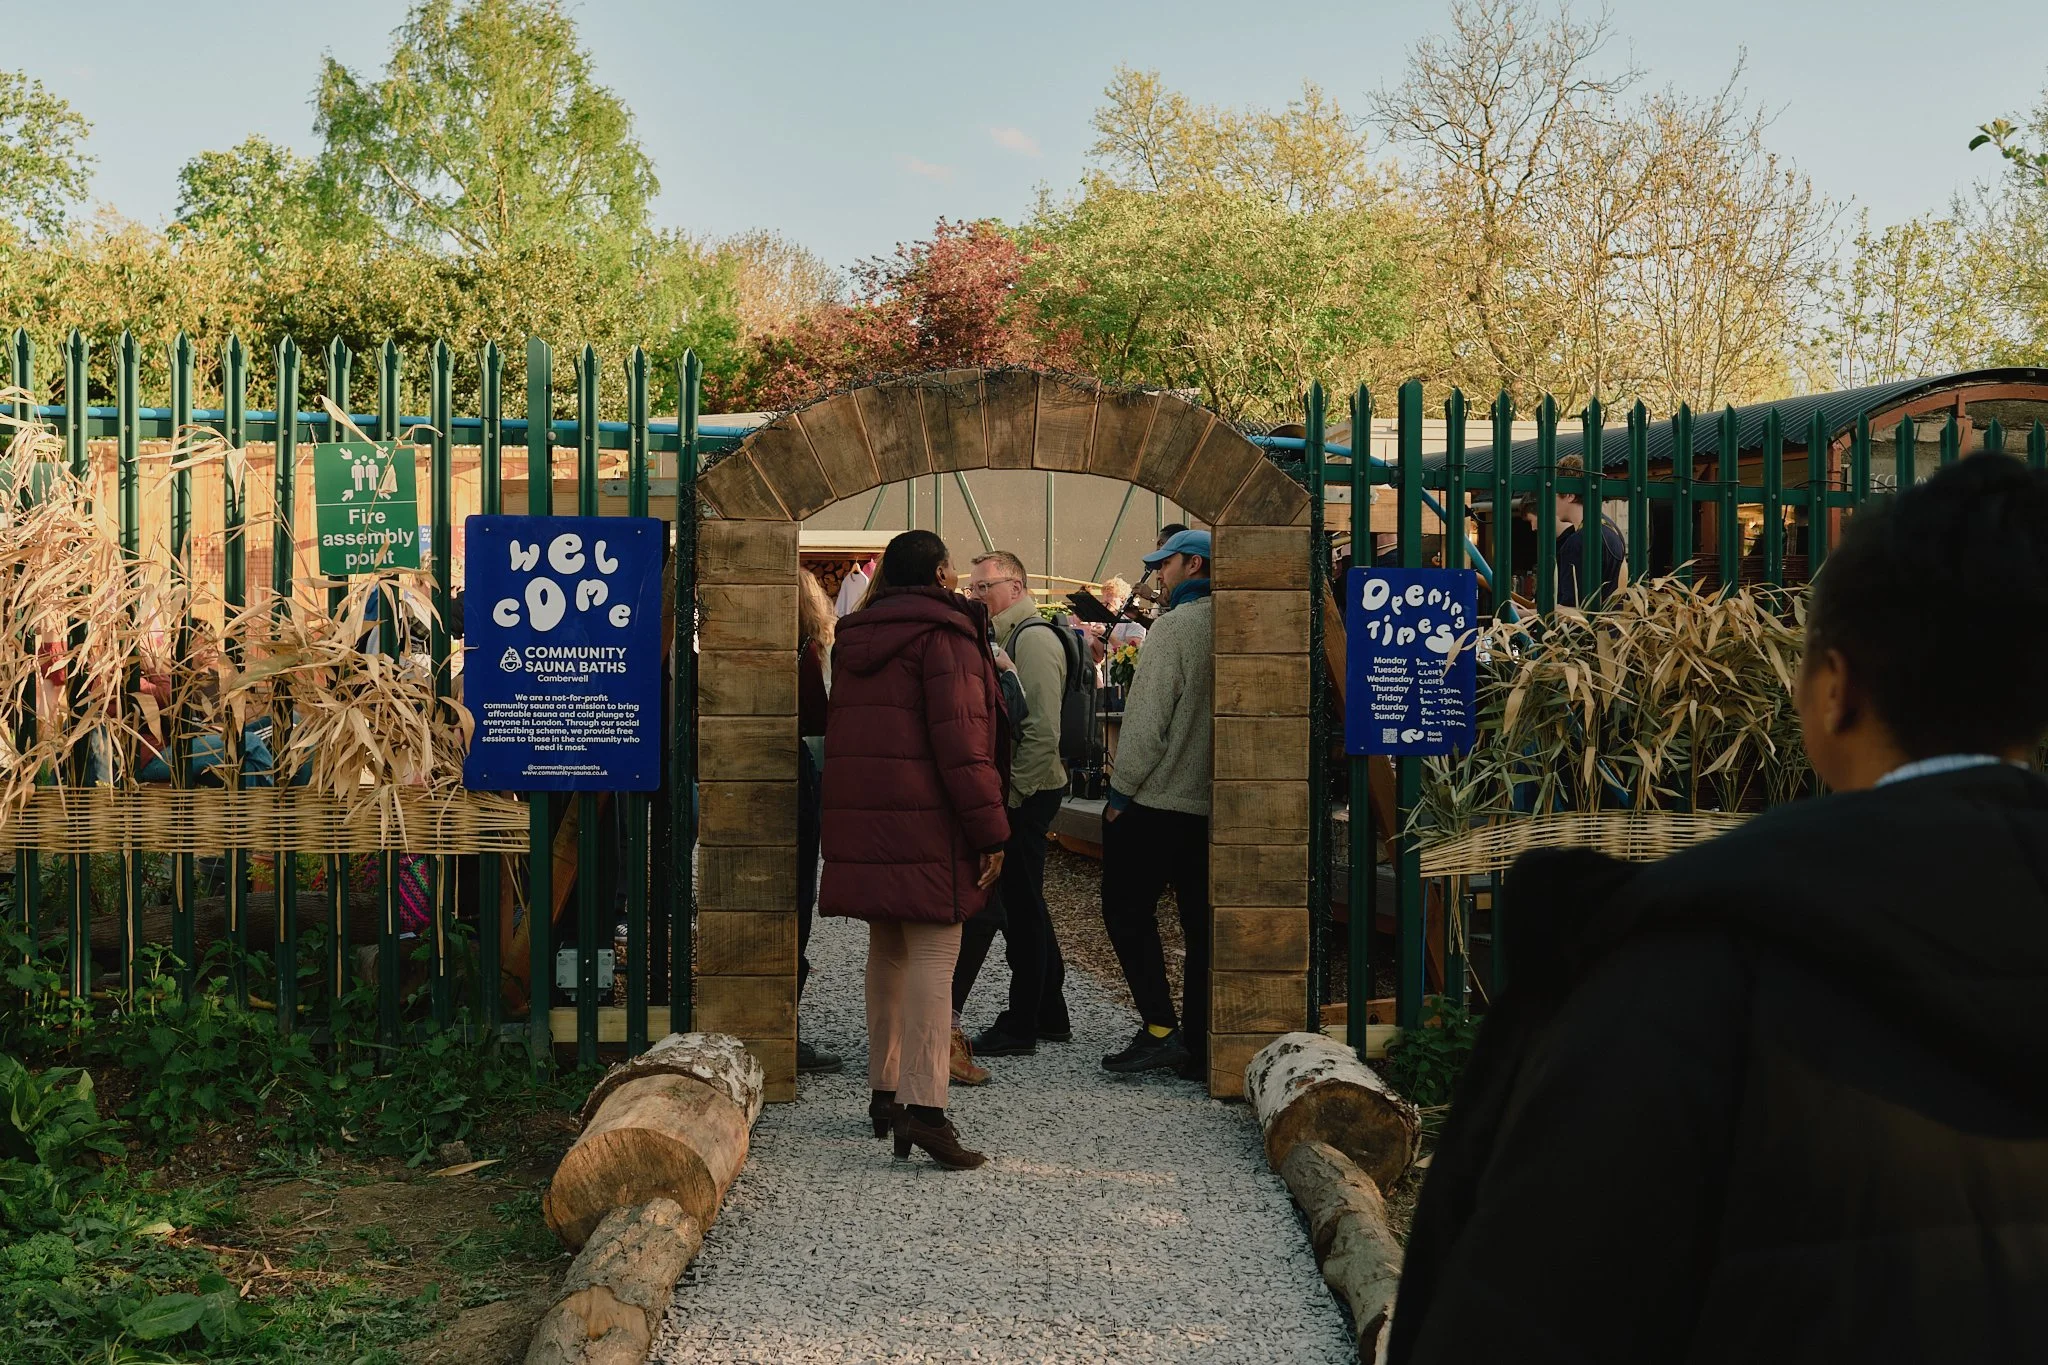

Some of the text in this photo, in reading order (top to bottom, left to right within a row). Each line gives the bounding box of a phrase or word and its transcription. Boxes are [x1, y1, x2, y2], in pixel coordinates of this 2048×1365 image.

[349, 509, 386, 525] Fire
[323, 528, 414, 548] assembly
[1362, 579, 1465, 629] Opening
[1367, 615, 1454, 653] Times
[525, 647, 627, 659] COMMUNITY
[1374, 657, 1407, 665] Monday
[525, 661, 626, 673] SAUNA BATHS
[1373, 666, 1407, 675] Tuesday
[1367, 676, 1413, 684] Wednesday
[1371, 685, 1409, 693] Thursday
[552, 694, 608, 703] not-for-profit
[1377, 694, 1403, 702] Friday
[484, 702, 528, 711] community
[618, 703, 639, 711] bring
[1371, 703, 1408, 712] Saturday
[596, 710, 623, 719] plunge
[1375, 713, 1405, 721] Sunday
[566, 719, 599, 727] Through
[489, 727, 534, 735] prescribing
[536, 727, 569, 735] scheme,
[584, 727, 615, 735] provide
[577, 736, 621, 744] community
